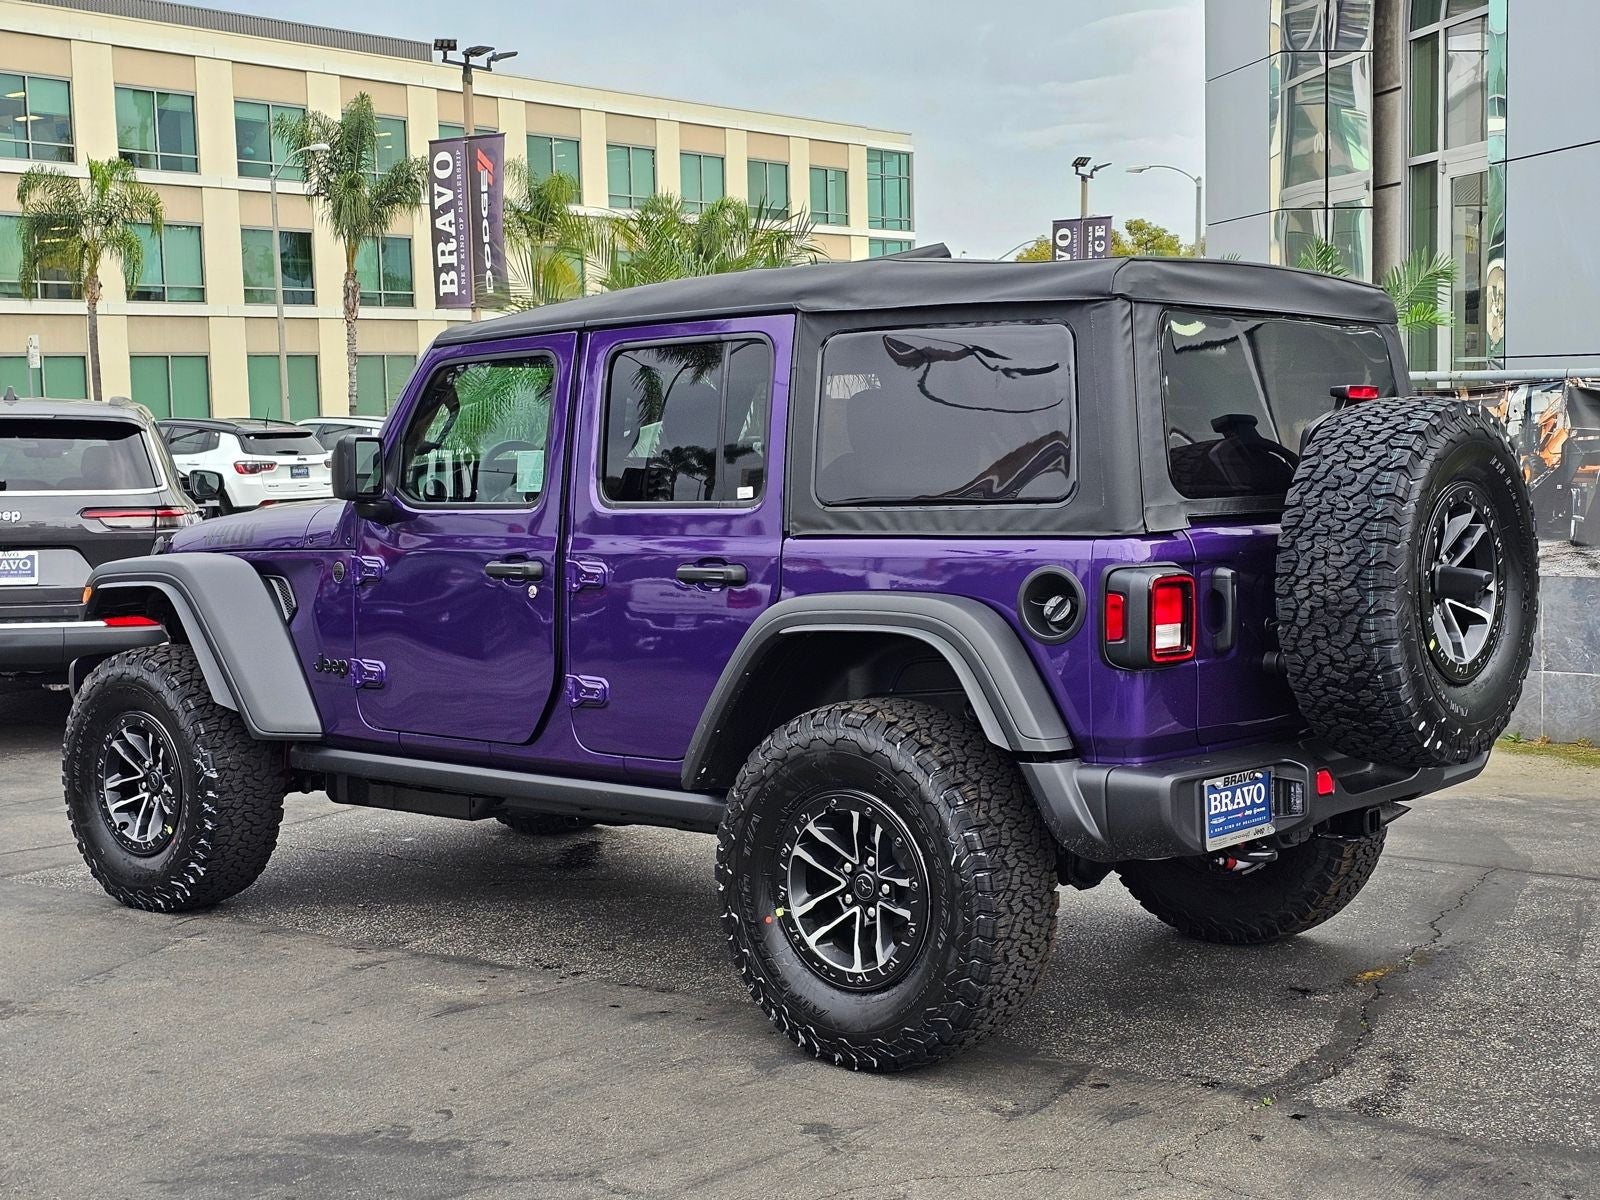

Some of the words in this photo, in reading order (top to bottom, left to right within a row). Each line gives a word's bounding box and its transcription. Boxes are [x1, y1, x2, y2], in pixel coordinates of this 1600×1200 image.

[433, 151, 458, 297] BRAVO
[459, 217, 464, 230] OF
[480, 169, 494, 294] DODGE
[0, 511, 21, 523] ep
[313, 652, 349, 679] Jeep
[1223, 770, 1256, 787] BRAVO
[1208, 783, 1266, 815] BRAVO
